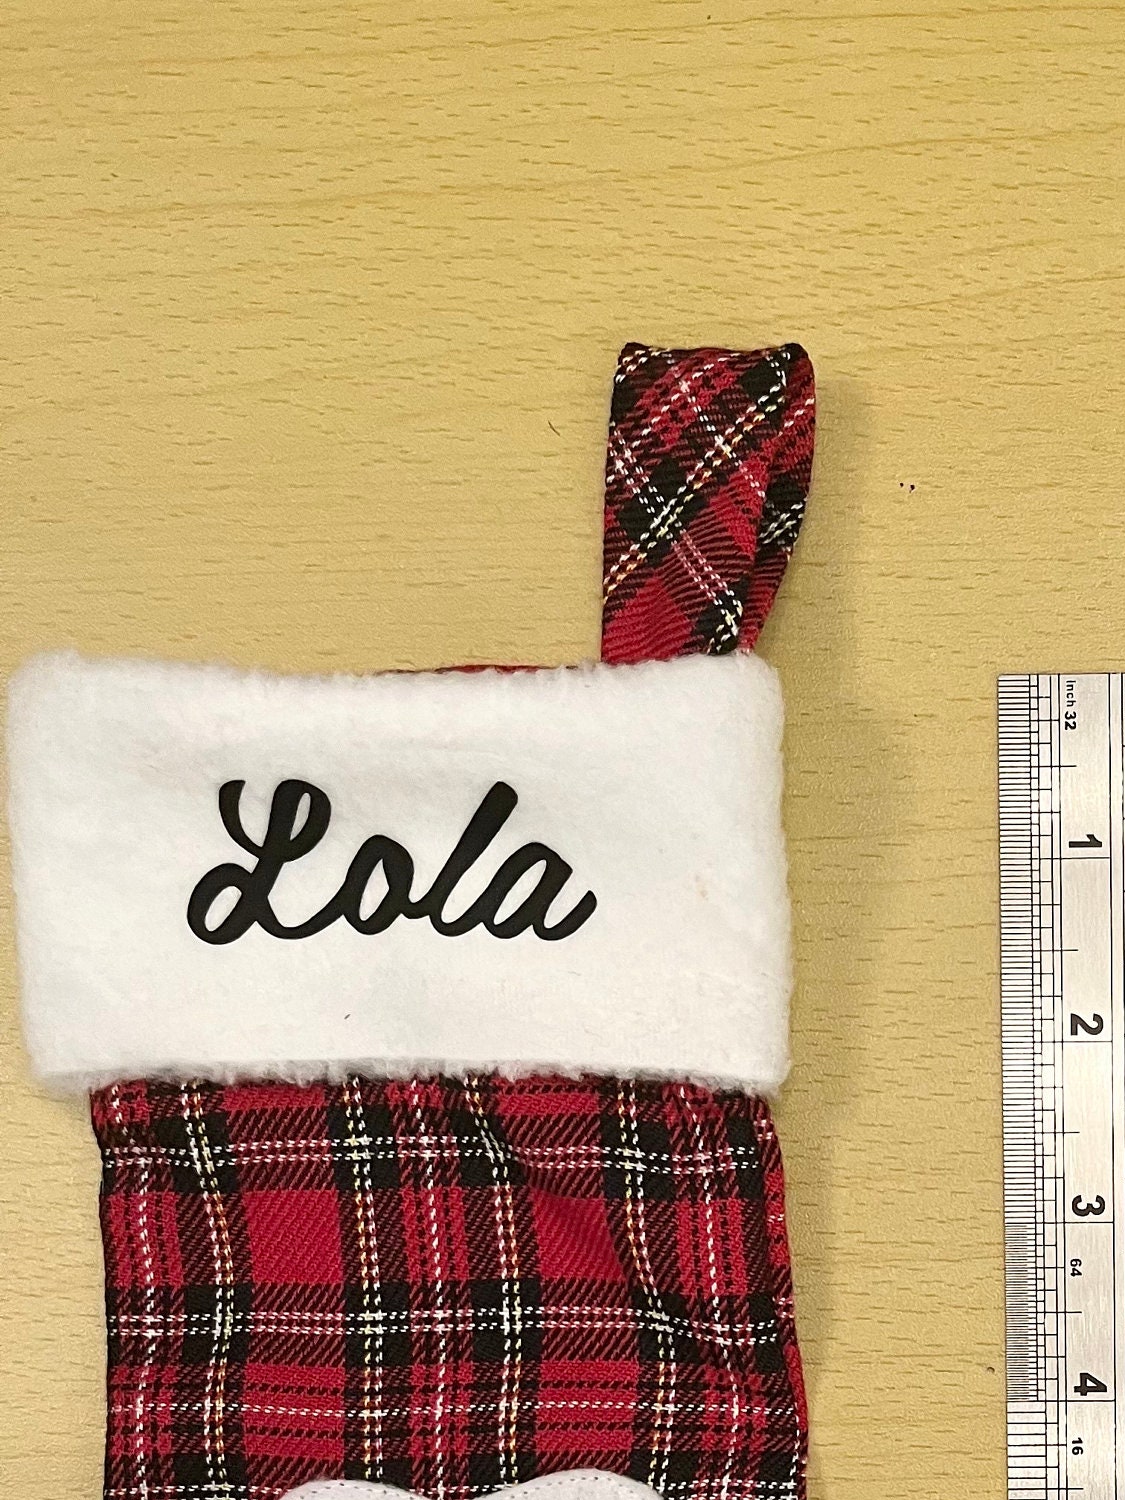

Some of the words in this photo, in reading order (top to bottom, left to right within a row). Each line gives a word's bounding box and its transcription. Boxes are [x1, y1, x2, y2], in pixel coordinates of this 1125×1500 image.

[1064, 679, 1077, 708] Inch
[1063, 711, 1077, 731] 32
[1068, 834, 1103, 848] 1
[187, 779, 597, 945] Lola
[1070, 1013, 1104, 1036] 2
[1071, 1195, 1105, 1217] 3
[1069, 1258, 1083, 1278] 64
[1073, 1372, 1108, 1396] 4
[1071, 1436, 1084, 1456] 16
